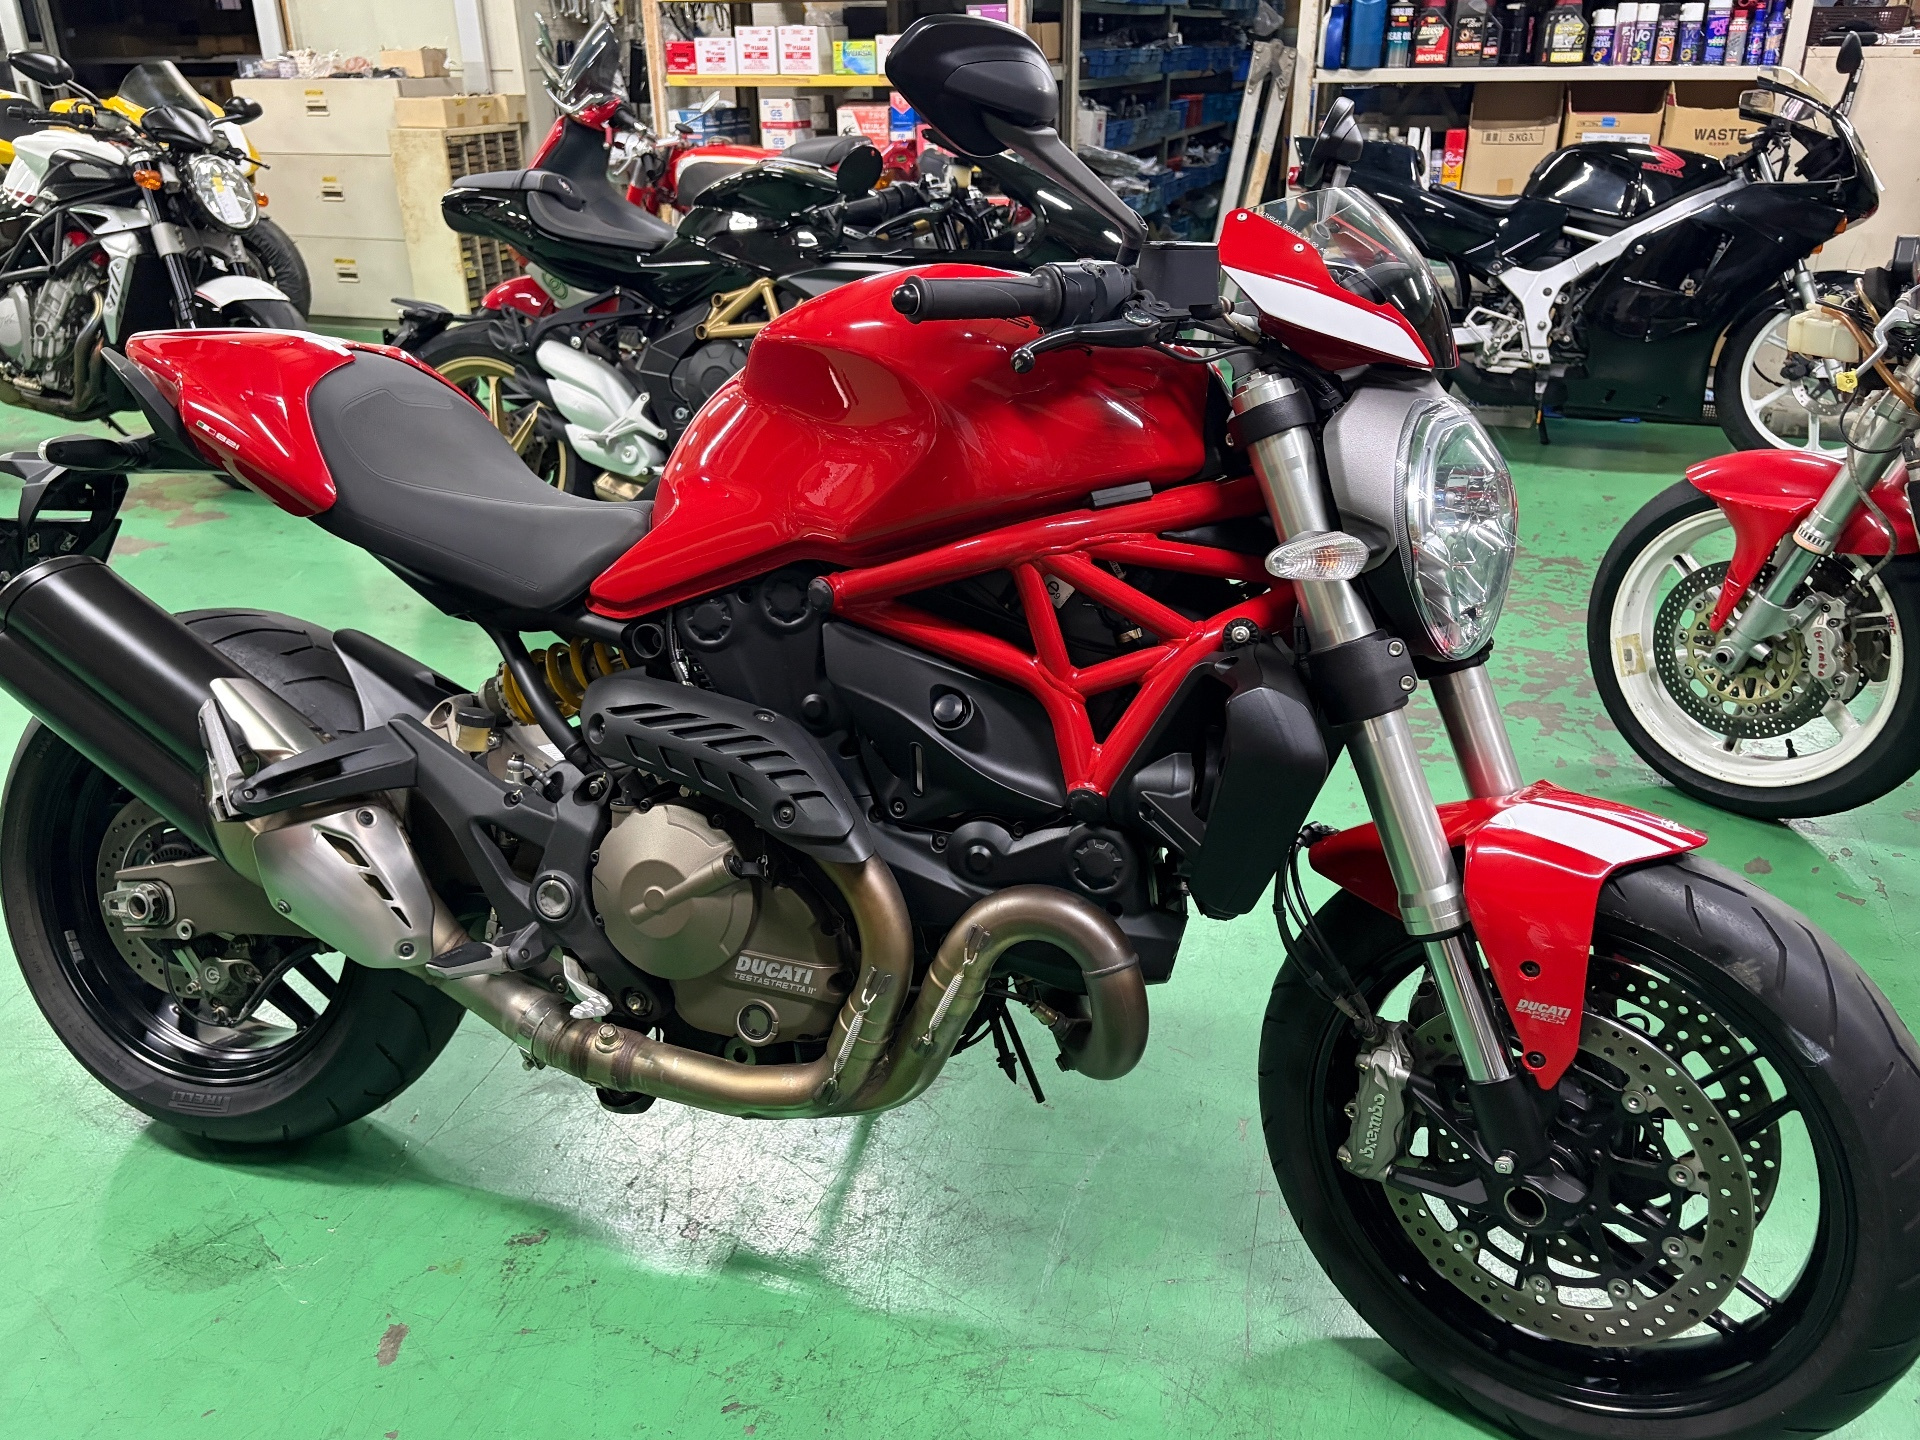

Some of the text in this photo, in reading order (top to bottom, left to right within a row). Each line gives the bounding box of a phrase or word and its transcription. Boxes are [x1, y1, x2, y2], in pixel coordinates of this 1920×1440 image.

[770, 109, 783, 117] GS
[772, 137, 785, 145] GS
[1641, 161, 1684, 178] HONDA
[215, 432, 240, 450] 821
[1813, 630, 1828, 677] brembo
[735, 955, 814, 985] DUCATI
[734, 971, 806, 993] TESTASTRETTA
[1517, 998, 1572, 1018] DUCATI
[1531, 1014, 1566, 1026] PACK
[168, 1090, 232, 1113] PIRELLI
[1358, 1093, 1386, 1160] brembo
